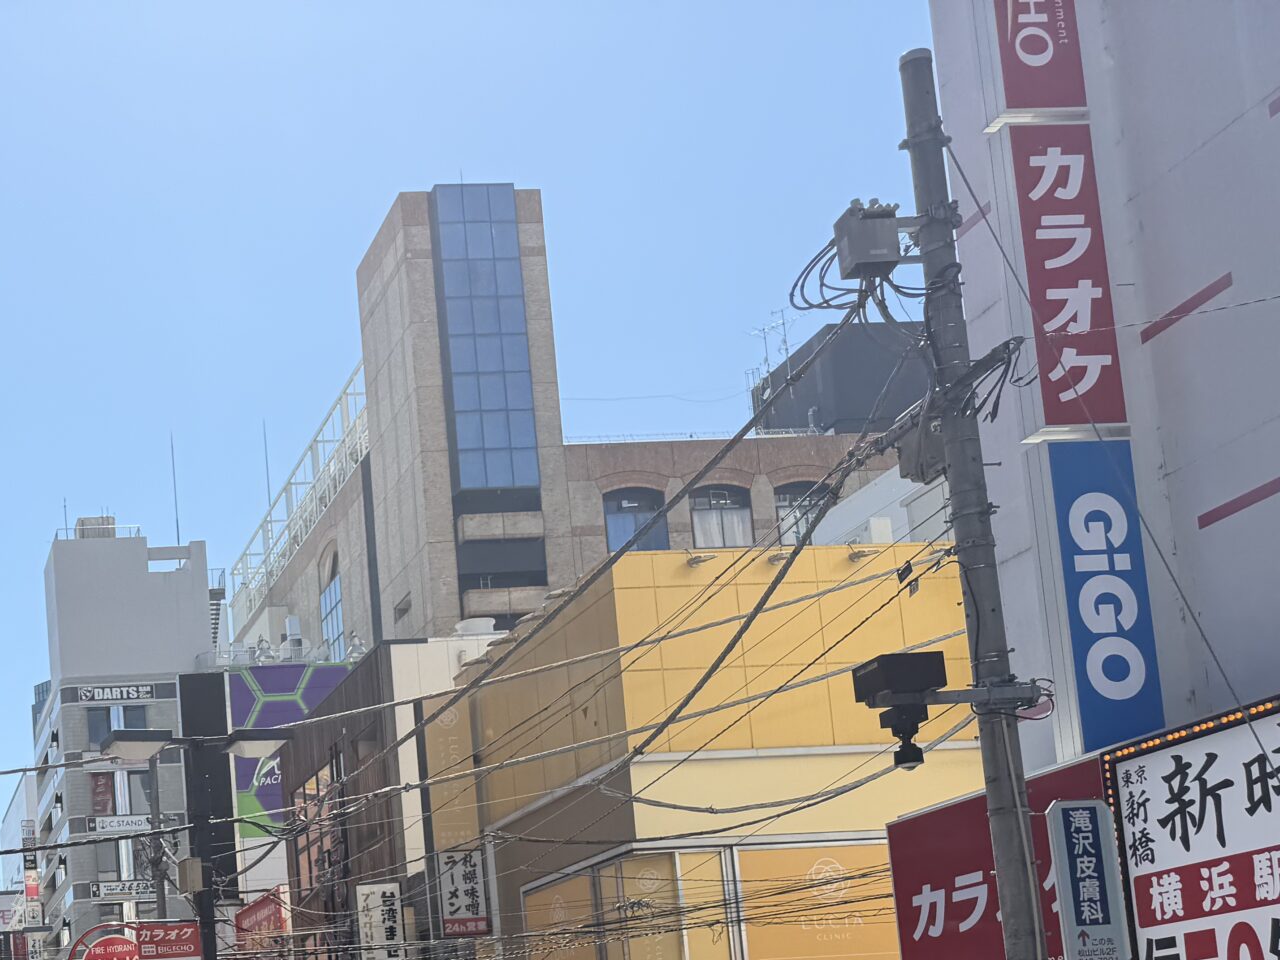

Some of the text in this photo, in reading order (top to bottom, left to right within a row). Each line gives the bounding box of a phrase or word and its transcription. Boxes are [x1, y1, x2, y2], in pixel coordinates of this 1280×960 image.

[1028, 146, 1112, 402] カラオケ
[94, 687, 138, 700] DARTS
[1121, 764, 1148, 788] 東京
[1124, 790, 1156, 868] 新橋
[444, 855, 462, 917] ラーメン
[461, 853, 481, 916] 札幌味噌
[1069, 809, 1104, 925] 滝沢皮膚科
[91, 943, 136, 954] FIRE HYDRANT
[139, 927, 195, 942] カラオケ
[1091, 938, 1115, 947] この先
